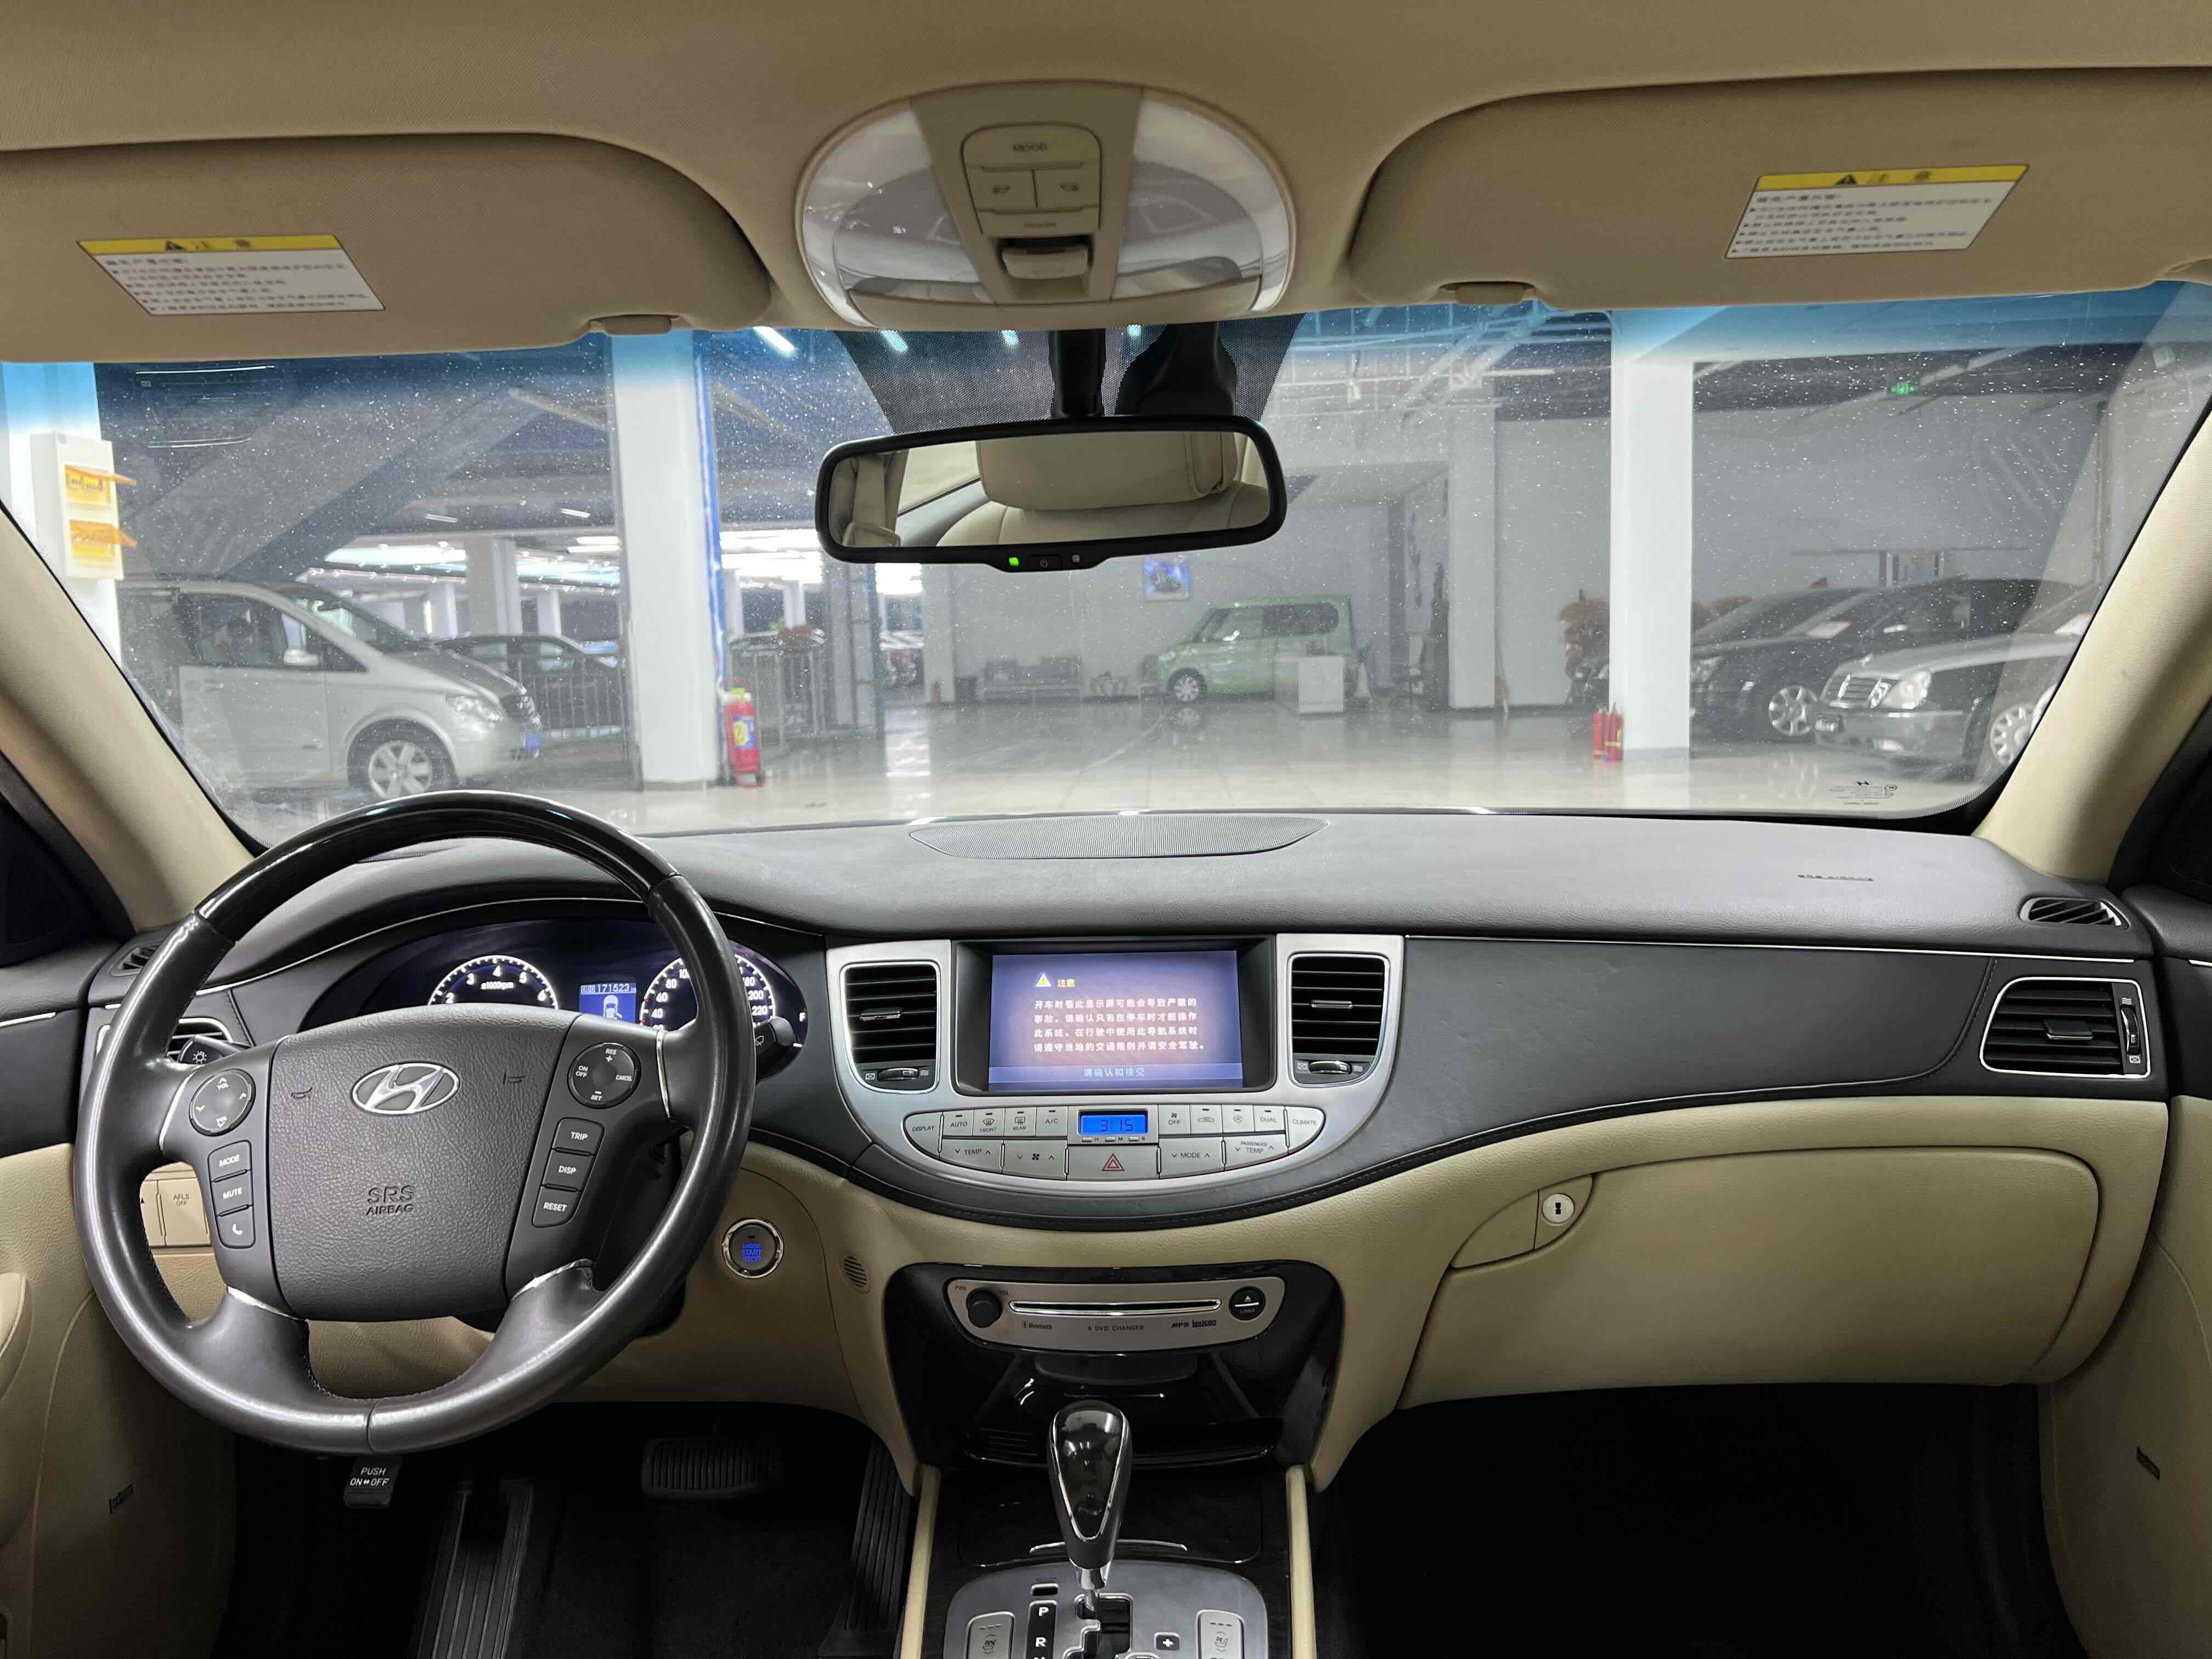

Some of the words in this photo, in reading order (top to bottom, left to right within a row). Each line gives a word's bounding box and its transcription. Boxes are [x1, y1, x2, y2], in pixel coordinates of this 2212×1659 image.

[493, 965, 500, 977] 4
[466, 973, 474, 985] 3
[519, 972, 527, 984] 5
[597, 984, 630, 992] 171523
[665, 979, 677, 989] 80
[1057, 979, 1075, 988] 注意
[537, 989, 546, 1001] 6
[656, 992, 668, 1002] 60
[748, 990, 764, 1000] 200
[651, 1008, 663, 1018] 40
[752, 1006, 768, 1015] 220
[1100, 1119, 1133, 1132] 3:15
[571, 1131, 589, 1141] TRIP
[219, 1154, 240, 1167] MODE
[558, 1165, 577, 1175] DISP
[222, 1187, 243, 1199] MUTE
[367, 1185, 414, 1205] SRS
[366, 1204, 414, 1216] AIRBAG
[543, 1201, 567, 1212] RESET
[360, 1468, 387, 1476] PUSH
[1038, 1607, 1049, 1616] P
[1035, 1637, 1046, 1647] R
